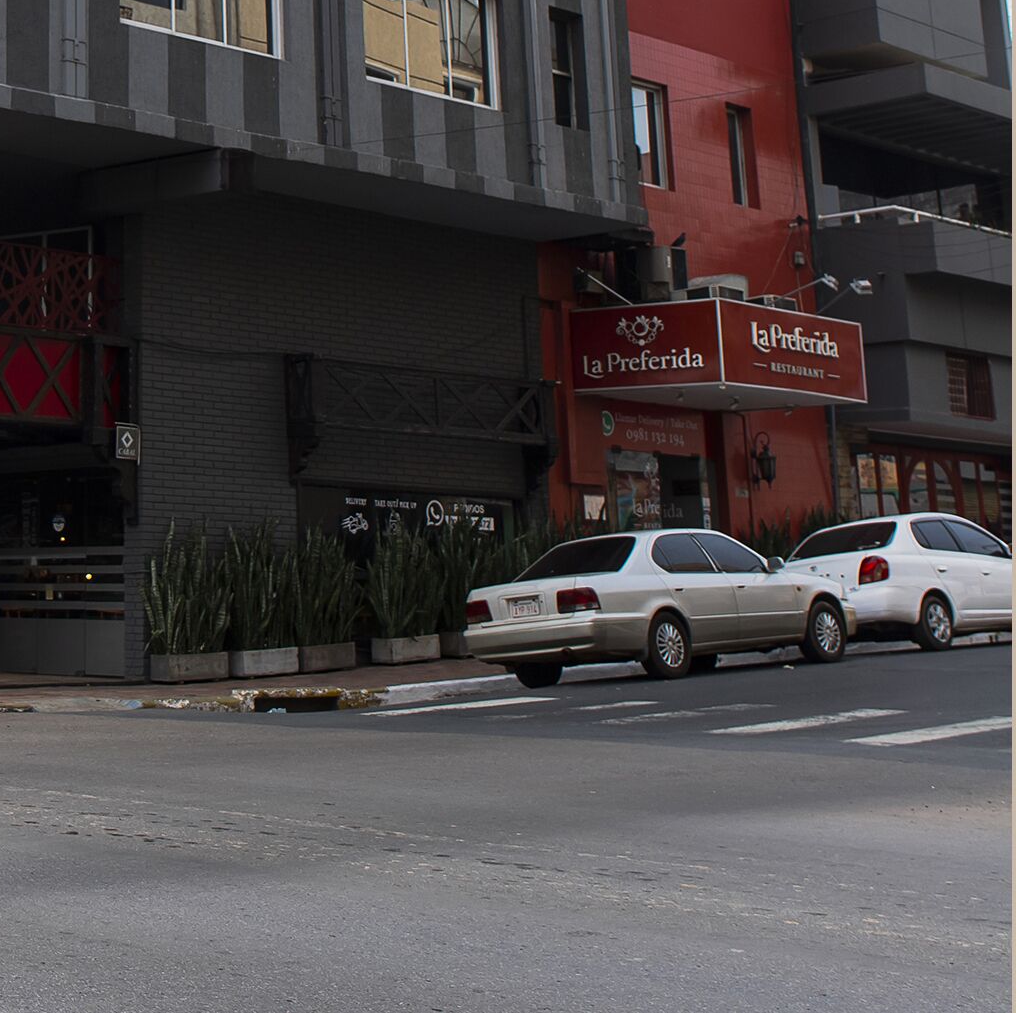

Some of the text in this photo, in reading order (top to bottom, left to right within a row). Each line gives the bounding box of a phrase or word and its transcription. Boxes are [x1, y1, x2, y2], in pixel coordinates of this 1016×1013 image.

[750, 321, 839, 358] La Preferida
[583, 347, 705, 379] La Preferida
[770, 362, 825, 379] RESTAURANT
[625, 427, 685, 447] 0981 132 194
